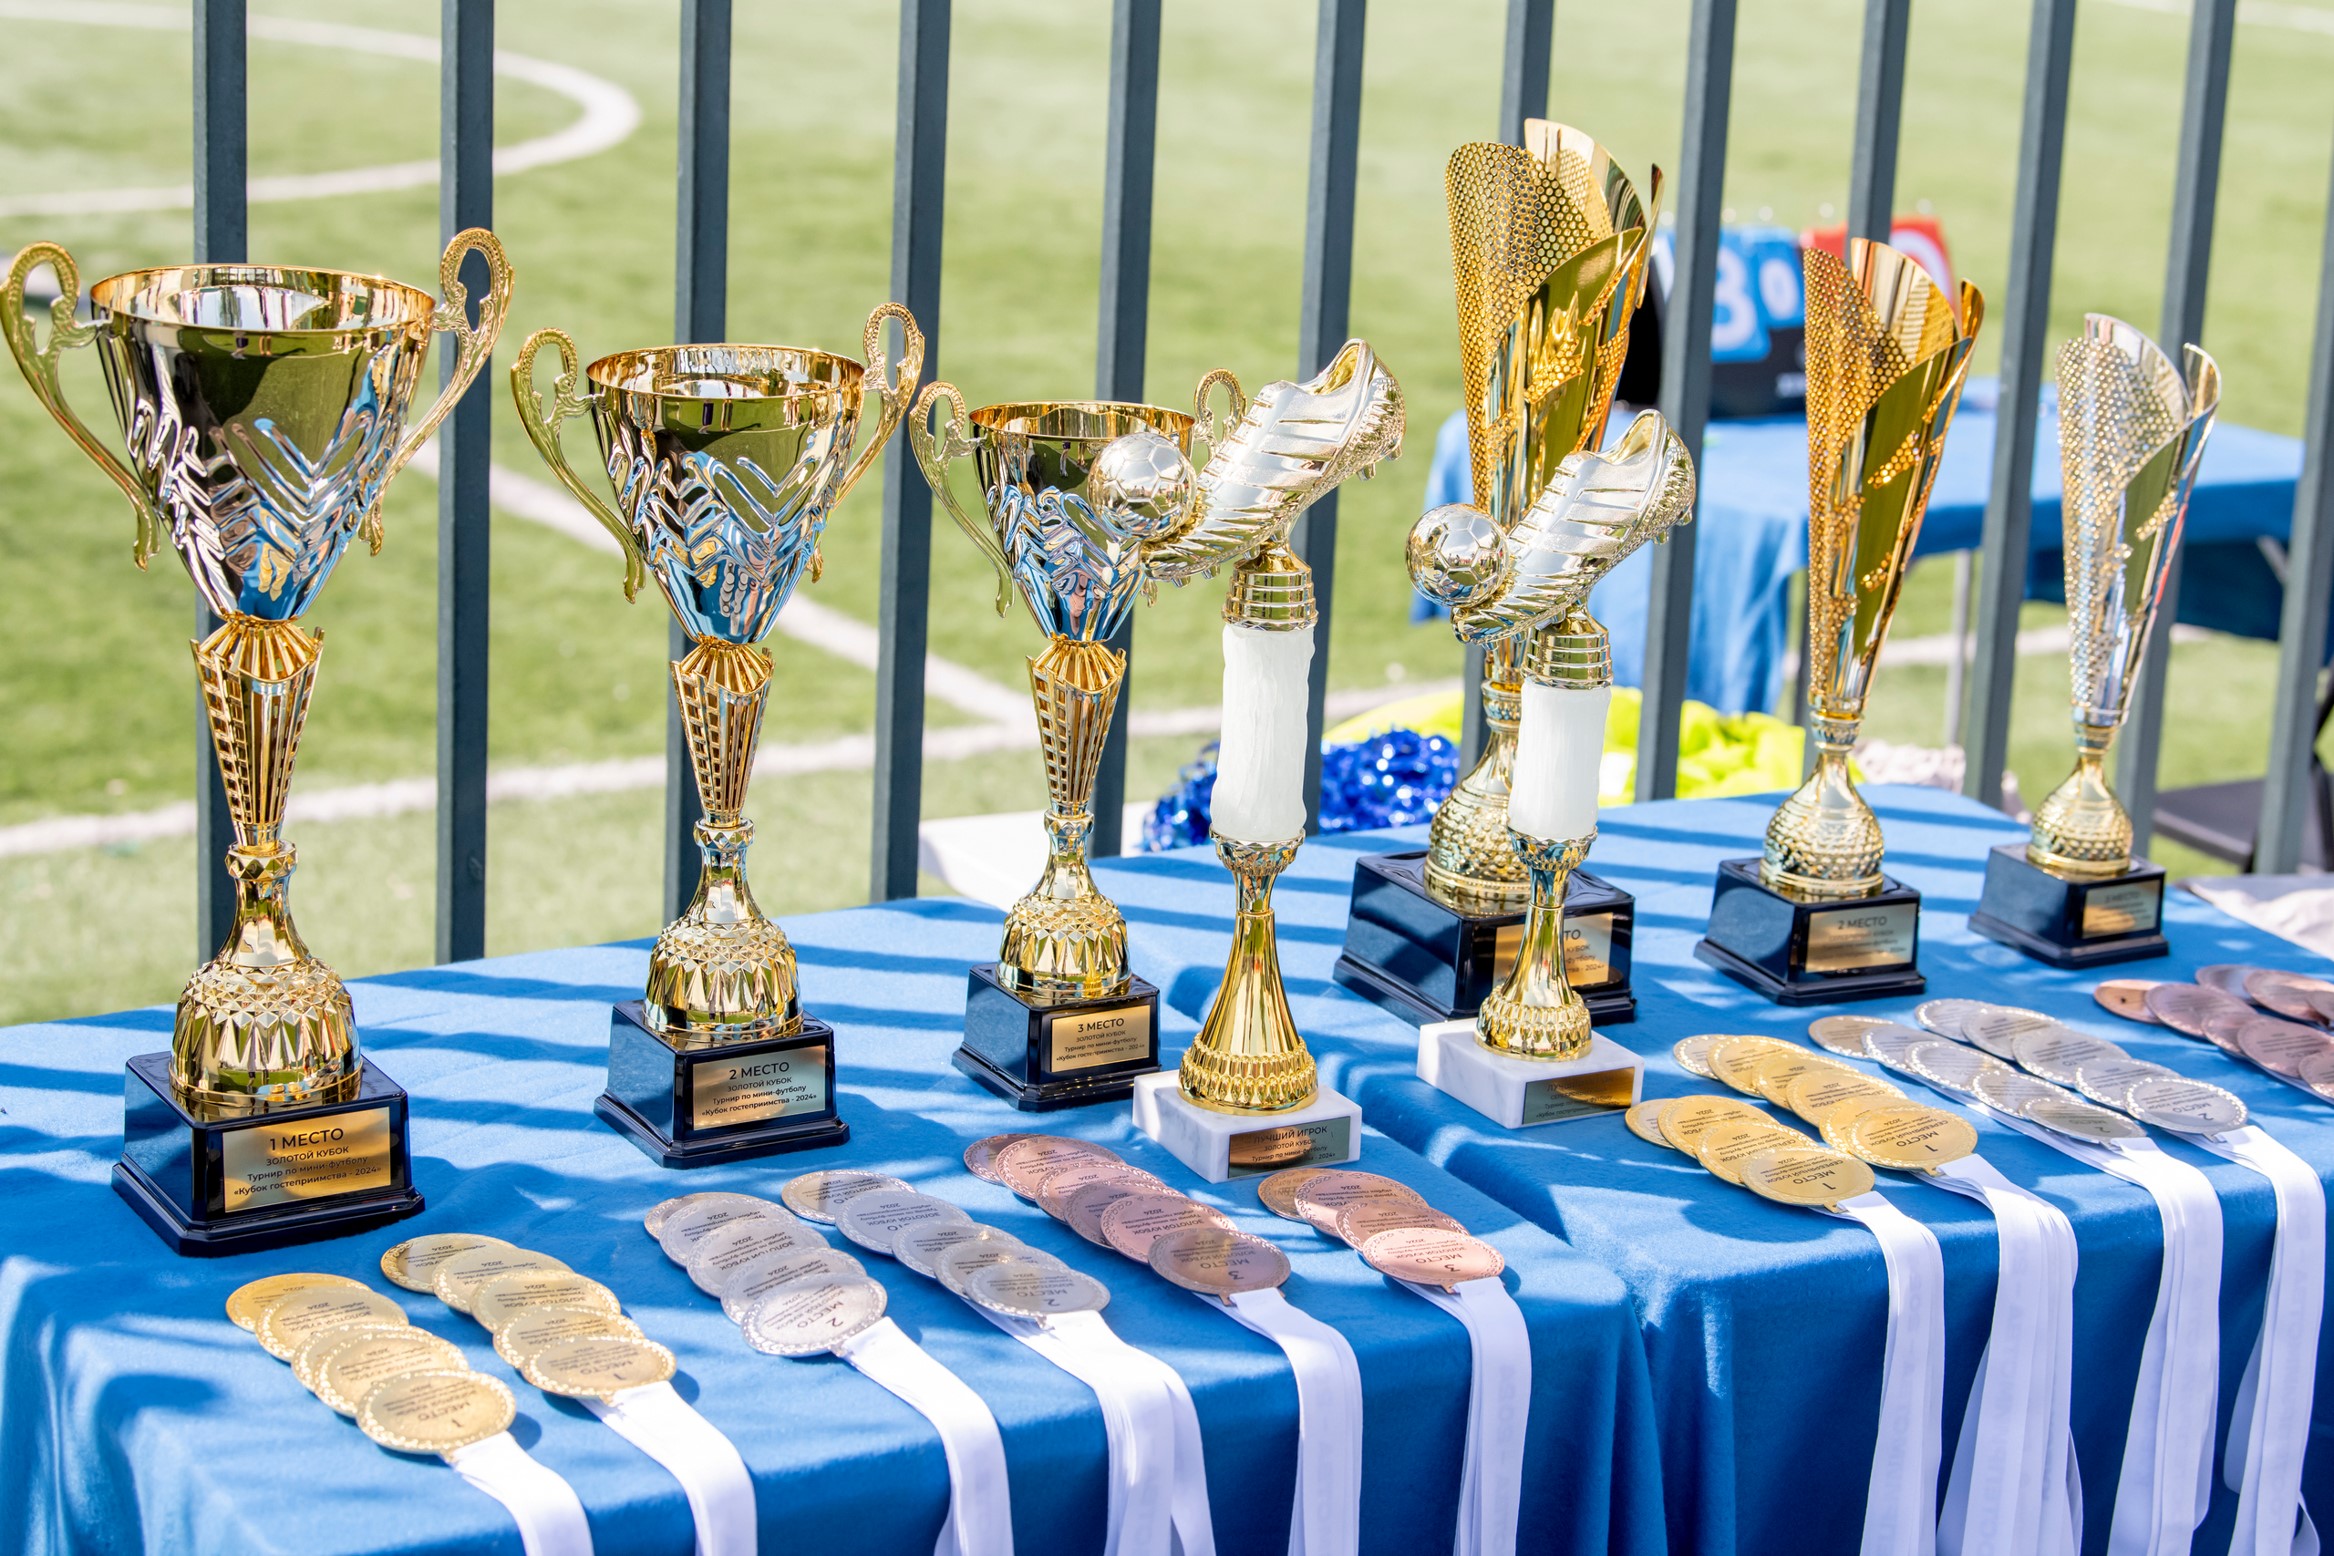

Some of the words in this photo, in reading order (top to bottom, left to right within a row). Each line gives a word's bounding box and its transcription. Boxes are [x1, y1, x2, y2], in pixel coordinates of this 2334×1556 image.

[1838, 919, 1844, 930] 2
[1847, 916, 1887, 928] МЕСТО
[1078, 1024, 1084, 1033] 3
[1087, 1018, 1124, 1031] МЕСТО
[1076, 1032, 1105, 1042] ЗОЛОТОЙ
[1106, 1030, 1127, 1038] КУБОК
[729, 1069, 737, 1080] 2
[741, 1061, 790, 1078] МЕСТО
[727, 1079, 765, 1092] ЗОЛОТОЙ
[766, 1077, 792, 1086] КУБОК
[713, 1095, 740, 1105] Турнир
[752, 1085, 807, 1098] мини-футболу
[702, 1106, 728, 1117] «Кубок
[729, 1097, 790, 1112] гостеприимства
[796, 1093, 817, 1102] 2024»
[2172, 1102, 2212, 1113] МЕСТО
[1695, 1108, 1714, 1116] 2024
[2197, 1112, 2214, 1121] 2
[1883, 1118, 1903, 1126] 2024
[1254, 1130, 1295, 1143] ЛУЧШИЙ
[1297, 1126, 1328, 1137] ИГРОК
[1896, 1120, 1949, 1139] СЕРЕБРЯНЫЙ
[2094, 1126, 2112, 1134] 2
[270, 1138, 276, 1151] 1
[282, 1128, 344, 1149] МЕСТО
[1731, 1133, 1751, 1141] 2024
[1869, 1136, 1896, 1146] КУБОК
[1896, 1130, 1939, 1147] МЕСТО
[1264, 1141, 1294, 1151] ЗОЛОТОЙ
[1295, 1138, 1317, 1146] КУБОК
[1925, 1144, 1938, 1152] 1
[266, 1149, 314, 1166] ЗОЛОТОЙ
[316, 1146, 350, 1159] КУБОК
[1037, 1149, 1058, 1157] 2024
[1778, 1157, 1796, 1165] 2024
[247, 1170, 283, 1184] Турнир
[285, 1167, 297, 1176] по
[299, 1156, 368, 1174] мини-футболу
[234, 1184, 268, 1198] «Кубок
[270, 1171, 347, 1190] гостеприимства
[355, 1166, 382, 1177] 2024»
[1792, 1170, 1836, 1185] МЕСТО
[1822, 1182, 1837, 1191] 1
[879, 1202, 901, 1210] 2024
[706, 1212, 729, 1221] 2024
[897, 1212, 941, 1223] ЗОЛОТОЙ
[1143, 1208, 1164, 1216] 2024
[866, 1218, 897, 1226] КУБОК
[1162, 1219, 1204, 1231] ЗОЛОТОЙ
[1132, 1226, 1162, 1236] КУБОК
[732, 1236, 754, 1246] 2024
[719, 1256, 750, 1271] КУБОК
[1200, 1258, 1250, 1269] МЕСТО
[1415, 1253, 1463, 1264] МЕСТО
[767, 1265, 790, 1277] 2024
[1444, 1263, 1461, 1273] 3
[1228, 1270, 1244, 1280] 3
[1016, 1289, 1068, 1298] МЕСТО
[1043, 1298, 1061, 1307] 2
[797, 1301, 844, 1328] МЕСТО
[825, 1317, 844, 1328] 2
